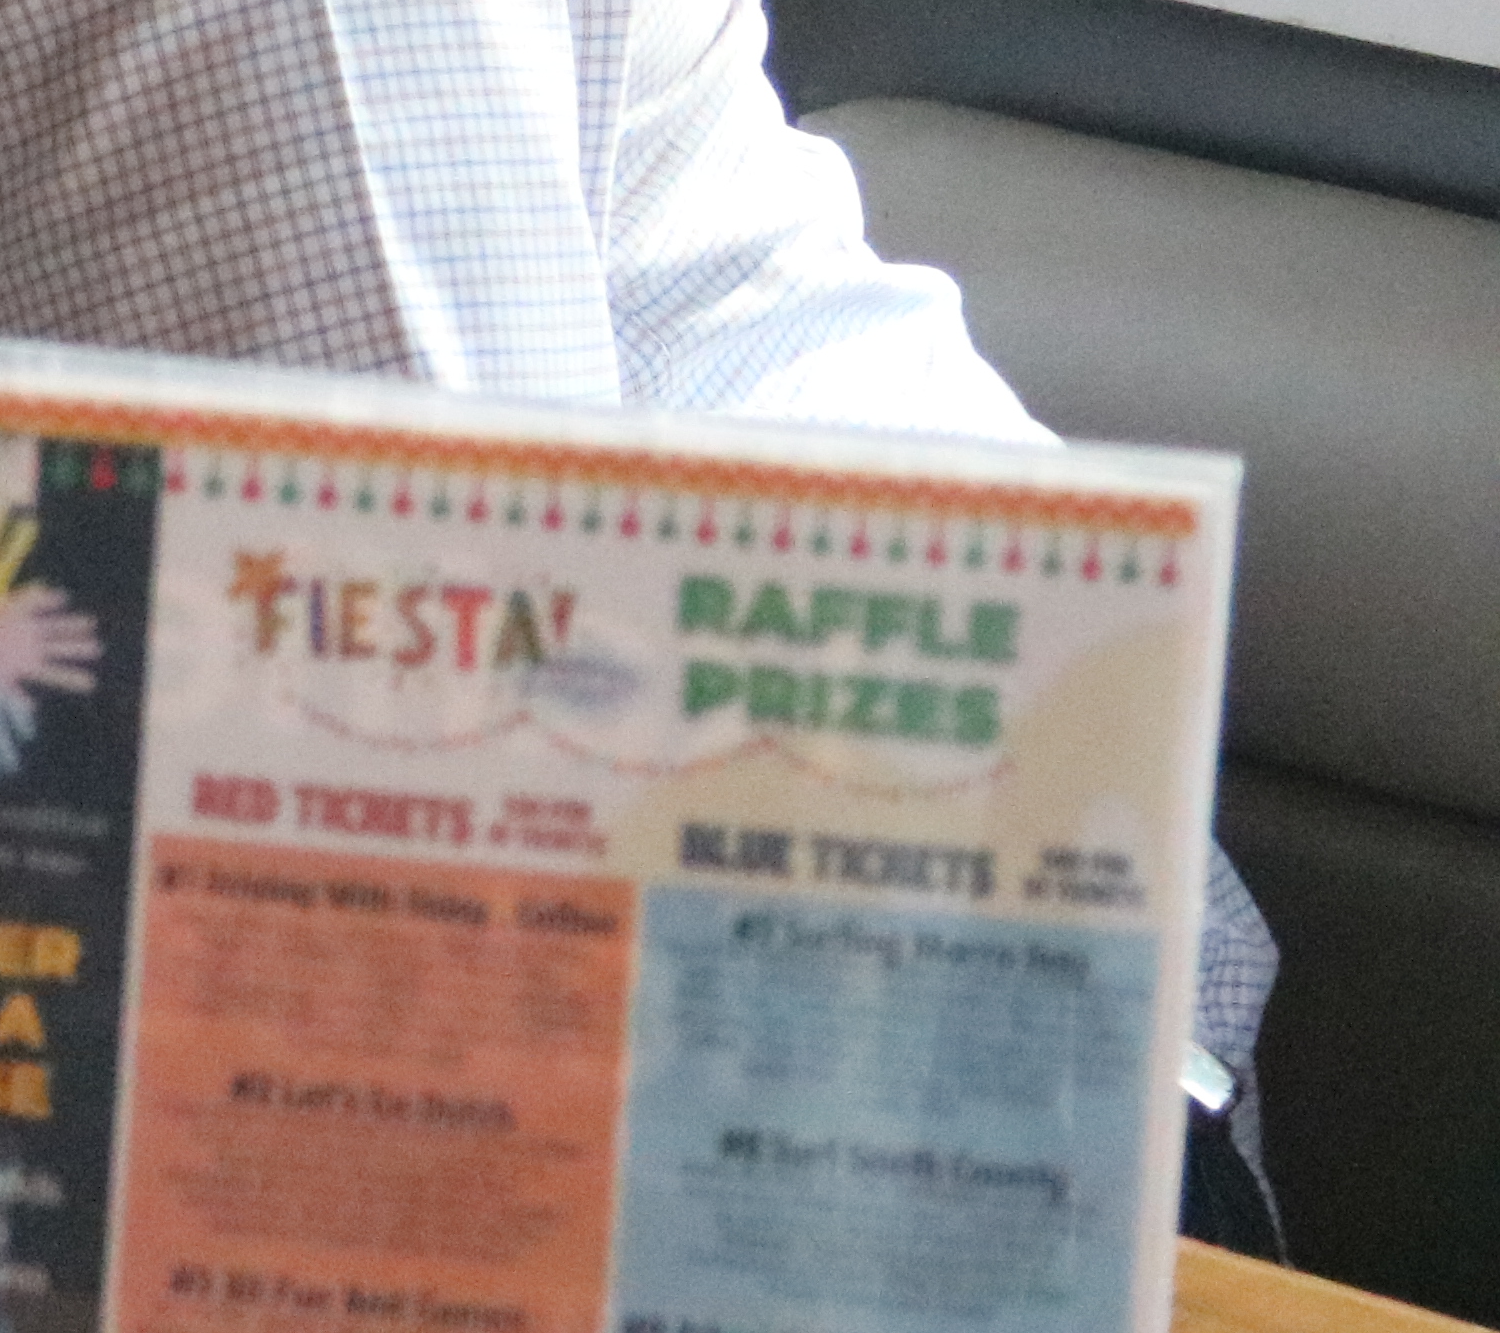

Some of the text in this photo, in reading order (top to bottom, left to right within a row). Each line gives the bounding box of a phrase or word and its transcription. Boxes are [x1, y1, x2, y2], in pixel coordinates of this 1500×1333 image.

[678, 573, 1019, 665] RAFFLE
[681, 658, 1002, 745] PRIZES
[192, 773, 280, 824] RED
[296, 783, 473, 846] TICKETS
[680, 822, 791, 877] BLUE
[812, 833, 995, 898] TICKETS
